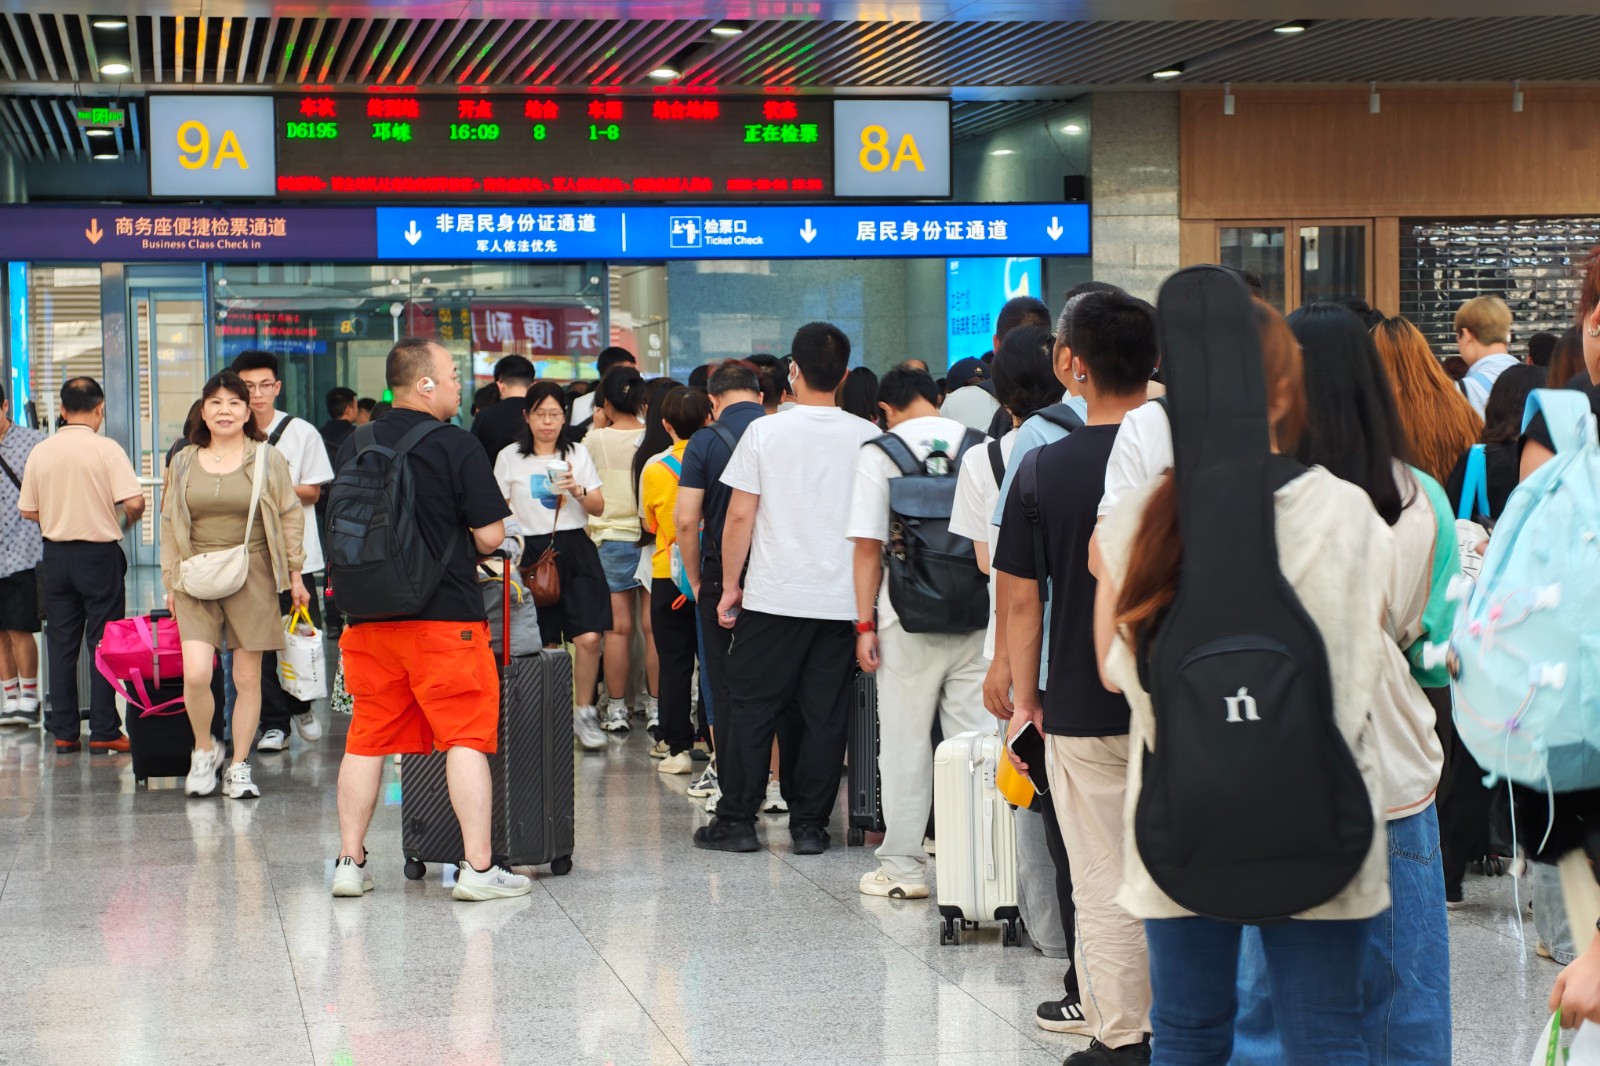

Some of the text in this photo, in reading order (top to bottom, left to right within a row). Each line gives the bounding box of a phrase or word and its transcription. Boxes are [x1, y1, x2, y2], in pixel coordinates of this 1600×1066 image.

[286, 121, 338, 139] D6195
[449, 123, 500, 141] 16:09
[532, 124, 547, 141] 8
[588, 124, 620, 141] 1-8
[743, 123, 820, 143] 正在检票
[176, 119, 249, 170] 9A
[859, 124, 926, 173] 8A
[114, 216, 287, 237] 商务座便捷检票通道
[435, 213, 597, 233] 非居民身份证通道
[704, 218, 747, 234] 检票口
[856, 219, 1009, 241] 居民身份证通道
[142, 239, 261, 250] Business Class Check in
[476, 239, 558, 253] 军人依法优先
[704, 235, 764, 245] Ticket Check
